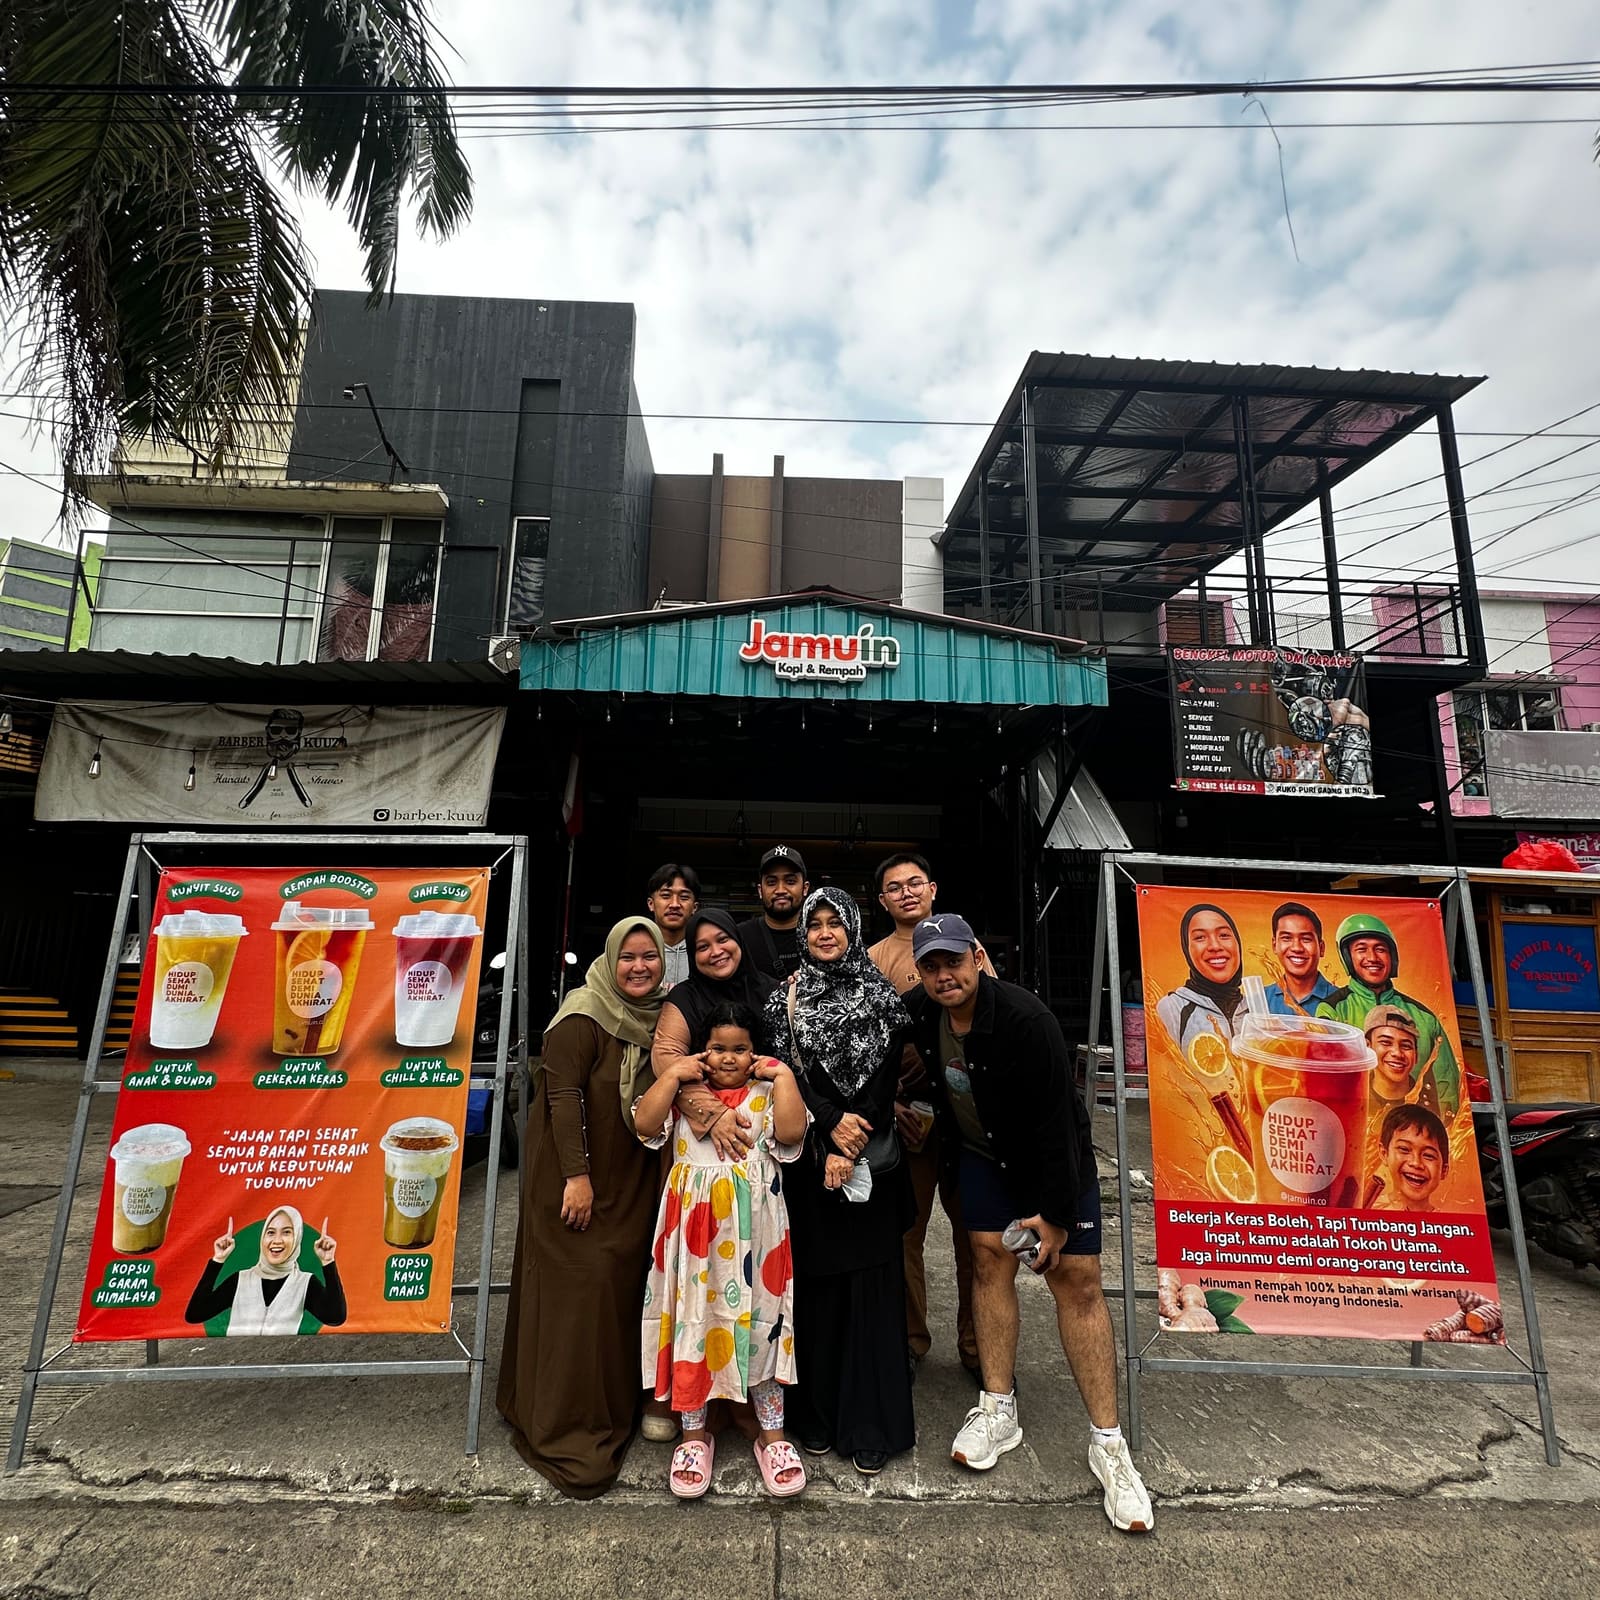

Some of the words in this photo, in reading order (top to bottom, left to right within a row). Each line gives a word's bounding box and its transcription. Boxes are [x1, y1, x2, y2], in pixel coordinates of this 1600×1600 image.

[741, 621, 898, 662] Jamuin
[1173, 648, 1230, 661] BENGKEL
[1232, 649, 1277, 662] MOTOR
[778, 662, 803, 676] Kopi
[806, 664, 815, 674] &
[819, 664, 863, 678] Rempah
[218, 736, 264, 747] BARBER
[1189, 734, 1230, 742] KARBURATOR
[1190, 744, 1224, 752] MODIFIKASI
[1214, 765, 1232, 773] PART
[308, 776, 343, 785] Shaves
[1276, 785, 1296, 793] RUKO
[1298, 786, 1316, 794] PURI
[171, 883, 211, 898] KUNYIT
[212, 883, 240, 897] SUSU
[284, 874, 326, 897] REMPAH
[329, 874, 374, 897] BOOSTER
[413, 886, 439, 898] JAHE
[441, 886, 468, 898] SUSU
[1509, 939, 1551, 972] BUBUR
[1556, 940, 1593, 975] AYAM
[291, 970, 324, 978] HIDUP
[291, 977, 325, 985] SEHAT
[290, 991, 321, 999] DUNIA
[290, 998, 335, 1006] AKHIRAT.
[155, 1062, 193, 1074] UNTUK
[284, 1061, 322, 1073] UNTUK
[405, 1060, 442, 1072] UNTUK
[128, 1074, 158, 1086] ANAK
[161, 1074, 171, 1086] &
[174, 1074, 213, 1086] BUNDA
[257, 1074, 307, 1086] PEKERJA
[309, 1073, 344, 1085] KERAS
[385, 1072, 416, 1083] CHILL
[419, 1072, 429, 1083] &
[432, 1071, 460, 1083] HEAL
[1268, 1111, 1314, 1129] HIDUP
[278, 1129, 310, 1142] TAPI
[315, 1128, 359, 1141] SEHAT
[1268, 1123, 1318, 1141] SEHAT
[1269, 1135, 1304, 1151] DEMI
[206, 1145, 255, 1159] SEMUA
[258, 1145, 307, 1158] BAHAN
[312, 1143, 369, 1158] TERBAIK
[1270, 1147, 1316, 1163] DUNIA
[219, 1160, 265, 1175] UNTUK
[269, 1160, 353, 1174] KEBUTUHAN
[1270, 1158, 1336, 1176] AKHIRAT.
[1280, 1191, 1327, 1206] @jamuin.co
[1168, 1209, 1222, 1227] Bekerja
[1225, 1211, 1264, 1227] Keras
[1267, 1212, 1313, 1230] Boleh,
[1316, 1215, 1346, 1233] Tapi
[1349, 1217, 1416, 1236] Tumbang
[1420, 1220, 1475, 1238] Jangan.
[1204, 1229, 1245, 1247] Ingat,
[1248, 1231, 1287, 1247] kamu
[1291, 1234, 1339, 1249] adalah
[1342, 1235, 1388, 1251] Tokoh
[1390, 1238, 1442, 1253] Utama.
[391, 1257, 429, 1269] KOPSU
[1181, 1248, 1212, 1265] Jaga
[1215, 1249, 1273, 1265] imunmu
[1276, 1252, 1313, 1267] demi
[1316, 1256, 1406, 1274] orang-orang
[1408, 1258, 1470, 1274] tercinta.
[111, 1263, 151, 1275] KOPSU
[393, 1270, 424, 1282] KAYU
[108, 1277, 148, 1289] GARAM
[1200, 1277, 1251, 1289] Minuman
[1254, 1279, 1302, 1294] Rempah
[1305, 1281, 1335, 1293] 100%
[1338, 1283, 1373, 1295] bahan
[1377, 1285, 1408, 1296] alami
[1411, 1288, 1457, 1299] warisan
[96, 1290, 156, 1304] HIMALAYA
[389, 1284, 425, 1297] MANIS
[1254, 1293, 1290, 1303] nenek
[1293, 1295, 1340, 1308] moyang
[1343, 1296, 1403, 1308] Indonesia.
